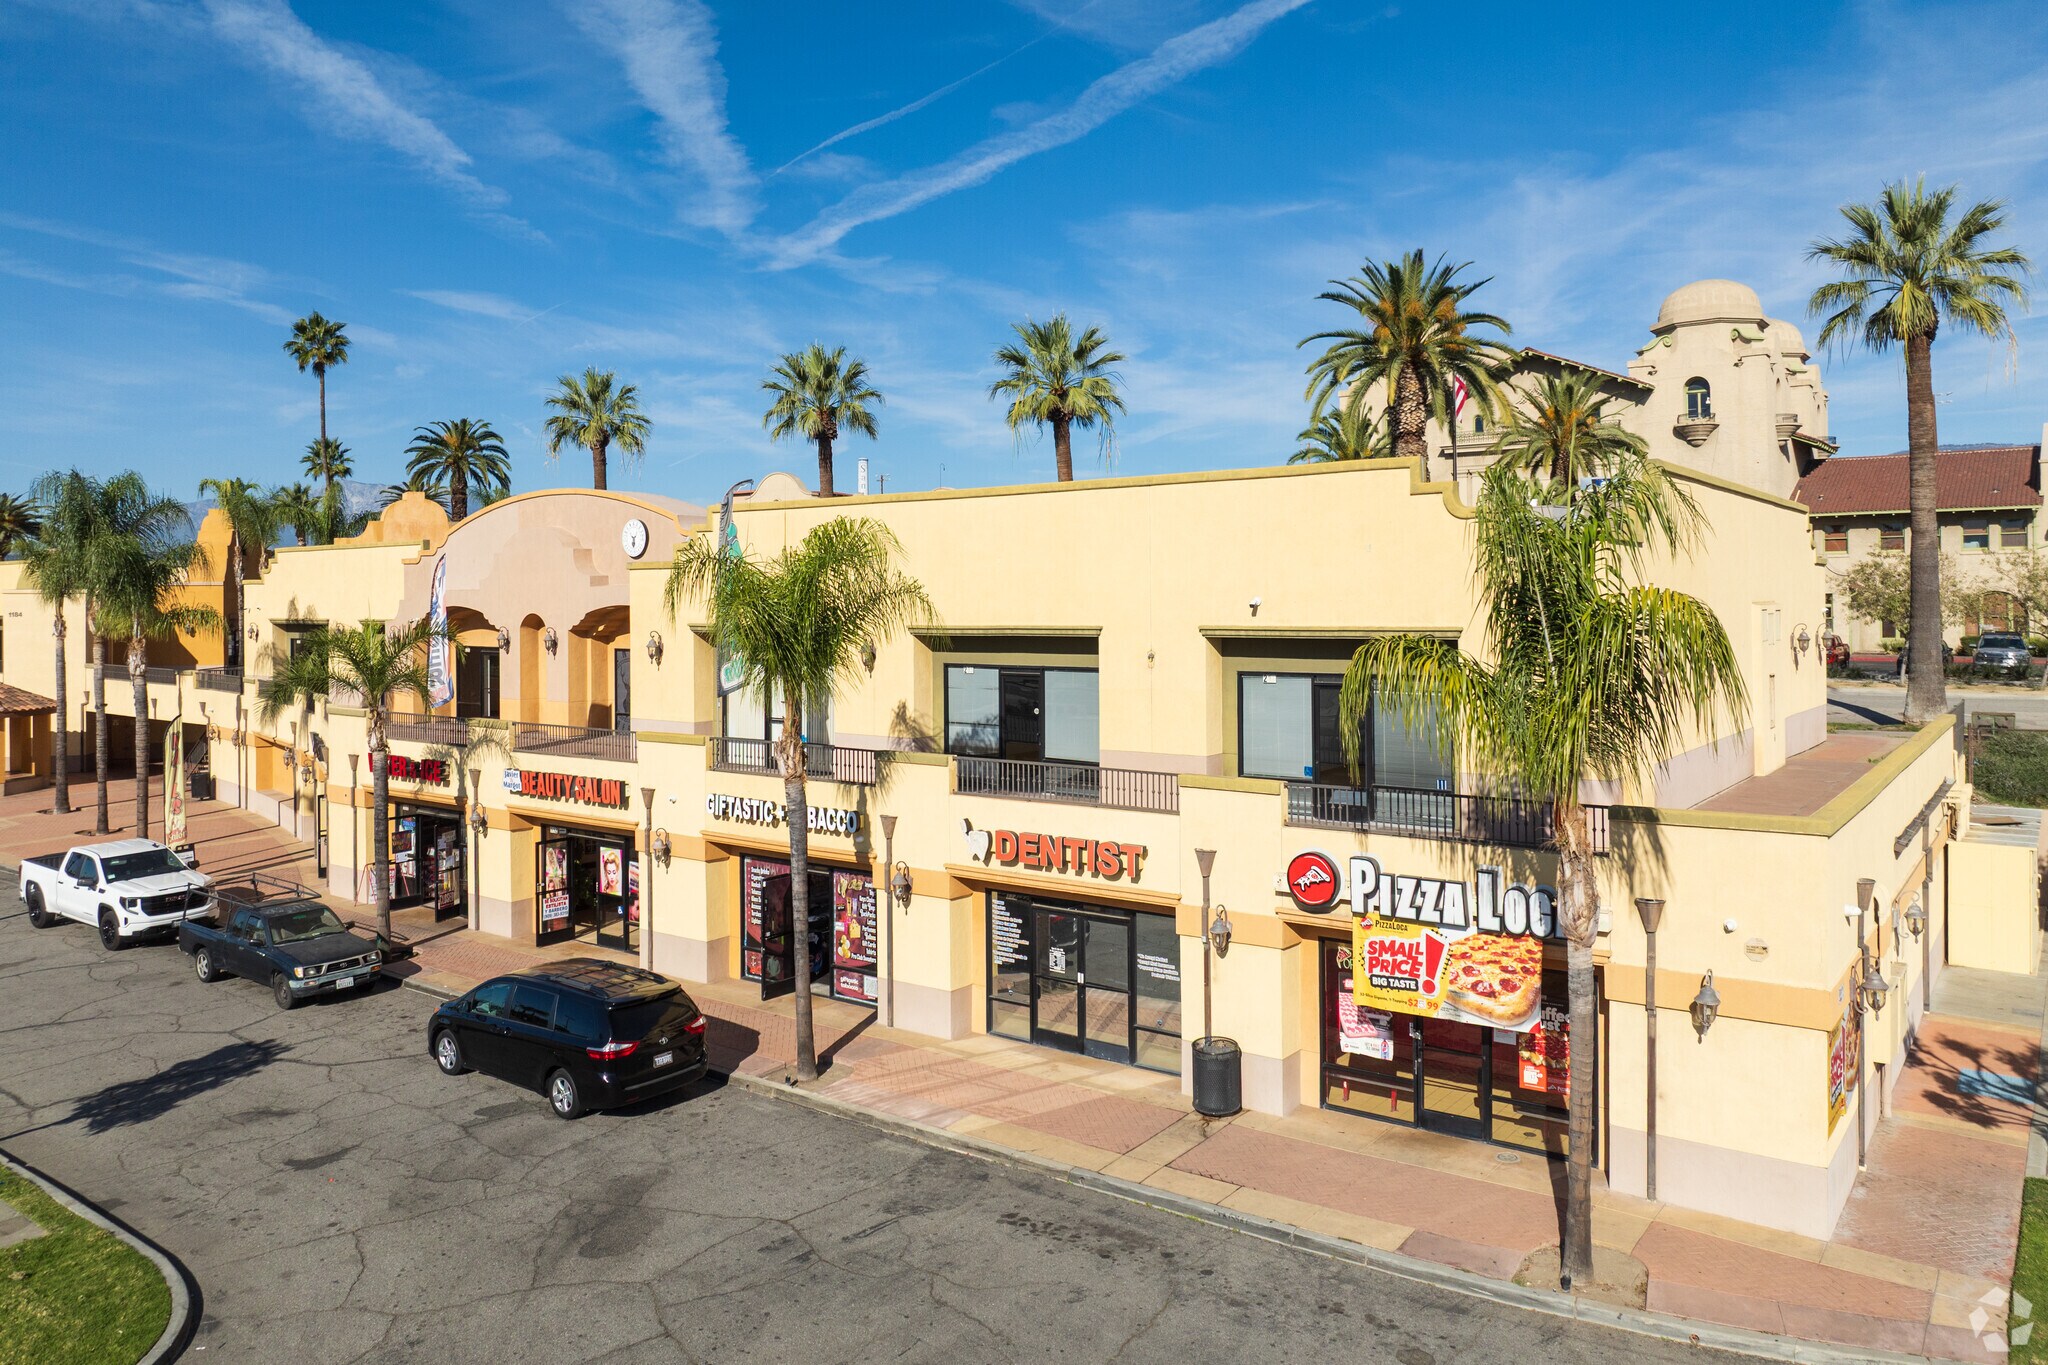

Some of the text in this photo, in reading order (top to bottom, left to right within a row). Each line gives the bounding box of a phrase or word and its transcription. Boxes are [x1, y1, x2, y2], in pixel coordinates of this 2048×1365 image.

[367, 753, 407, 778] TER
[420, 759, 442, 783] ICE
[521, 770, 621, 805] BEAUTY SALON
[706, 793, 774, 823] GIFTASTIC
[790, 805, 858, 834] BACCO
[995, 830, 1144, 878] DENTIST
[1350, 856, 1566, 940] PIZZA LOC
[1367, 940, 1424, 960] SMALL
[1372, 976, 1417, 990] BIG TASTE
